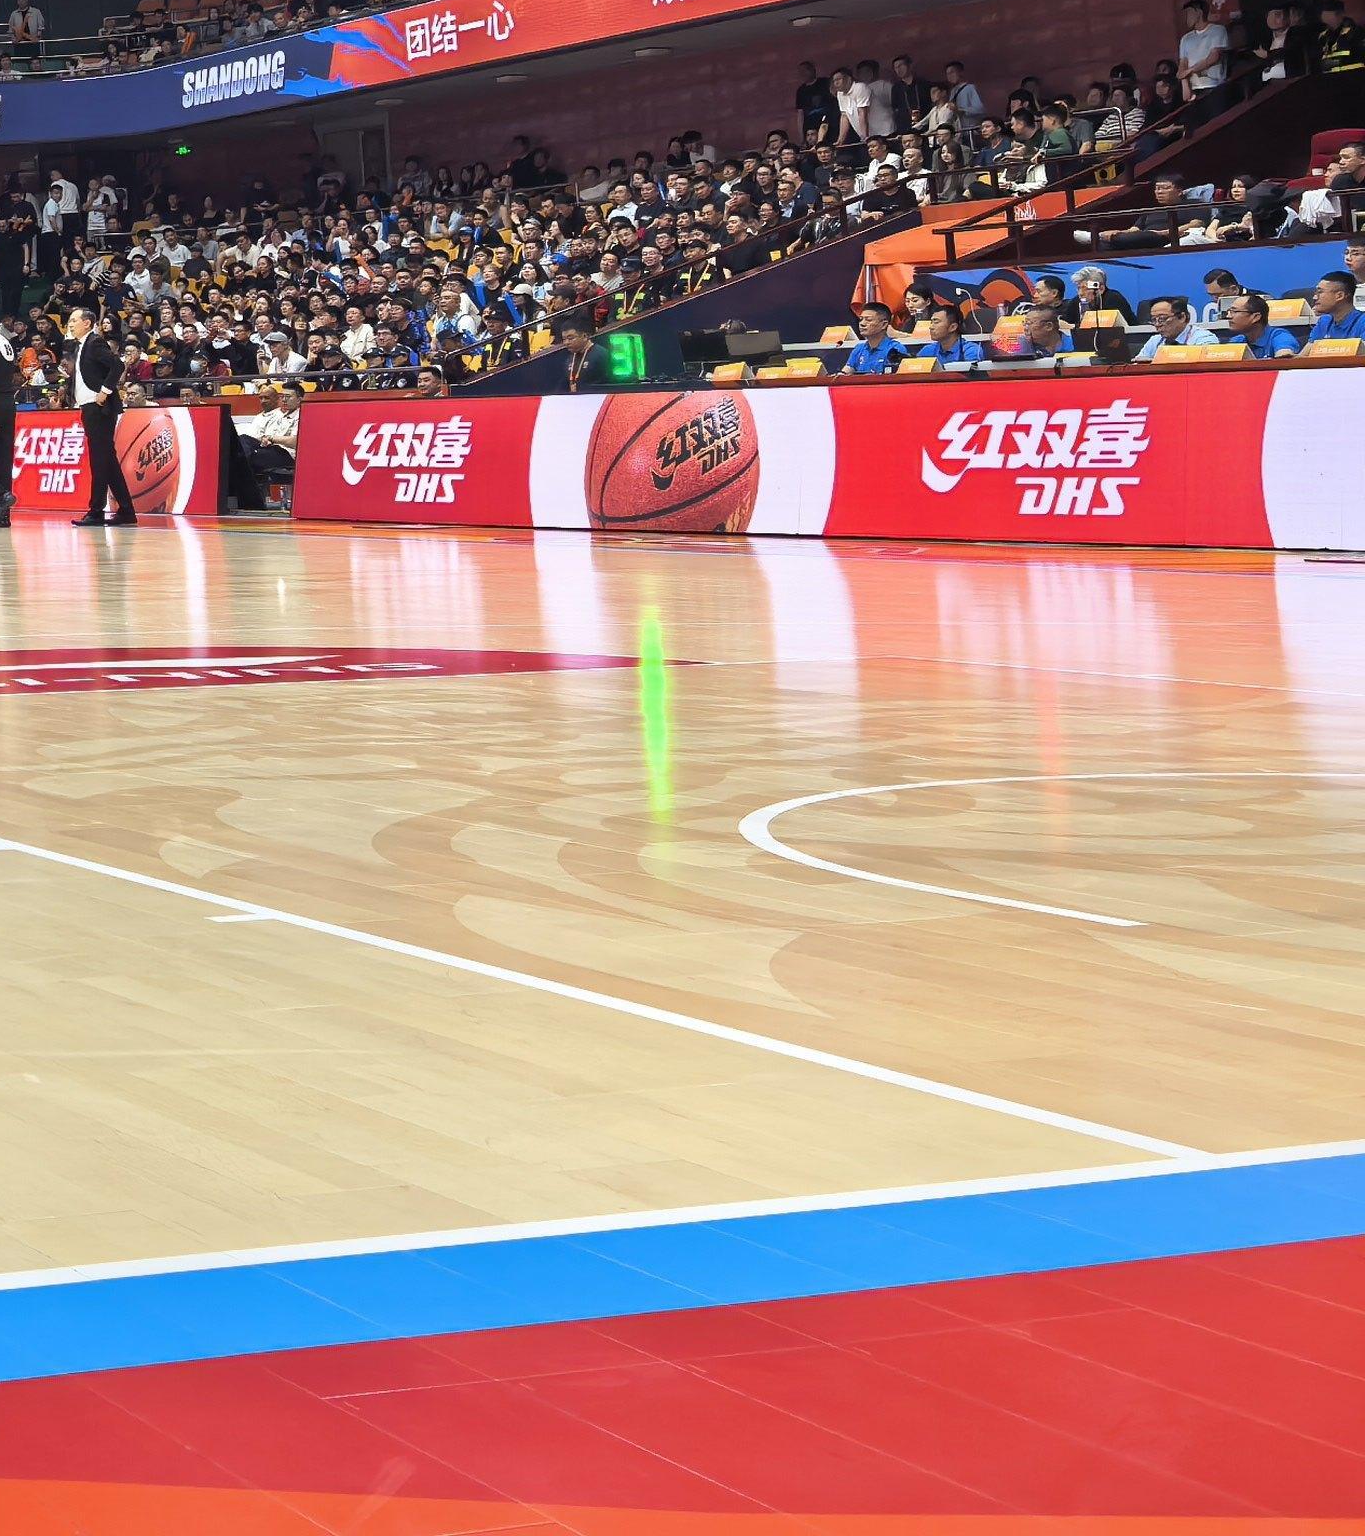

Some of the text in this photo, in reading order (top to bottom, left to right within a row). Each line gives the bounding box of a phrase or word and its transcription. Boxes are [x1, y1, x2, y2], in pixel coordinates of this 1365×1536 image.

[405, 0, 515, 61] 团结一心
[181, 51, 286, 110] SHANDONG
[15, 422, 85, 465] 红双喜
[352, 414, 473, 468] 红双喜
[938, 398, 1152, 470] 红双喜
[39, 469, 81, 493] DHS
[394, 473, 465, 504] DHS
[1015, 477, 1141, 516] DHS
